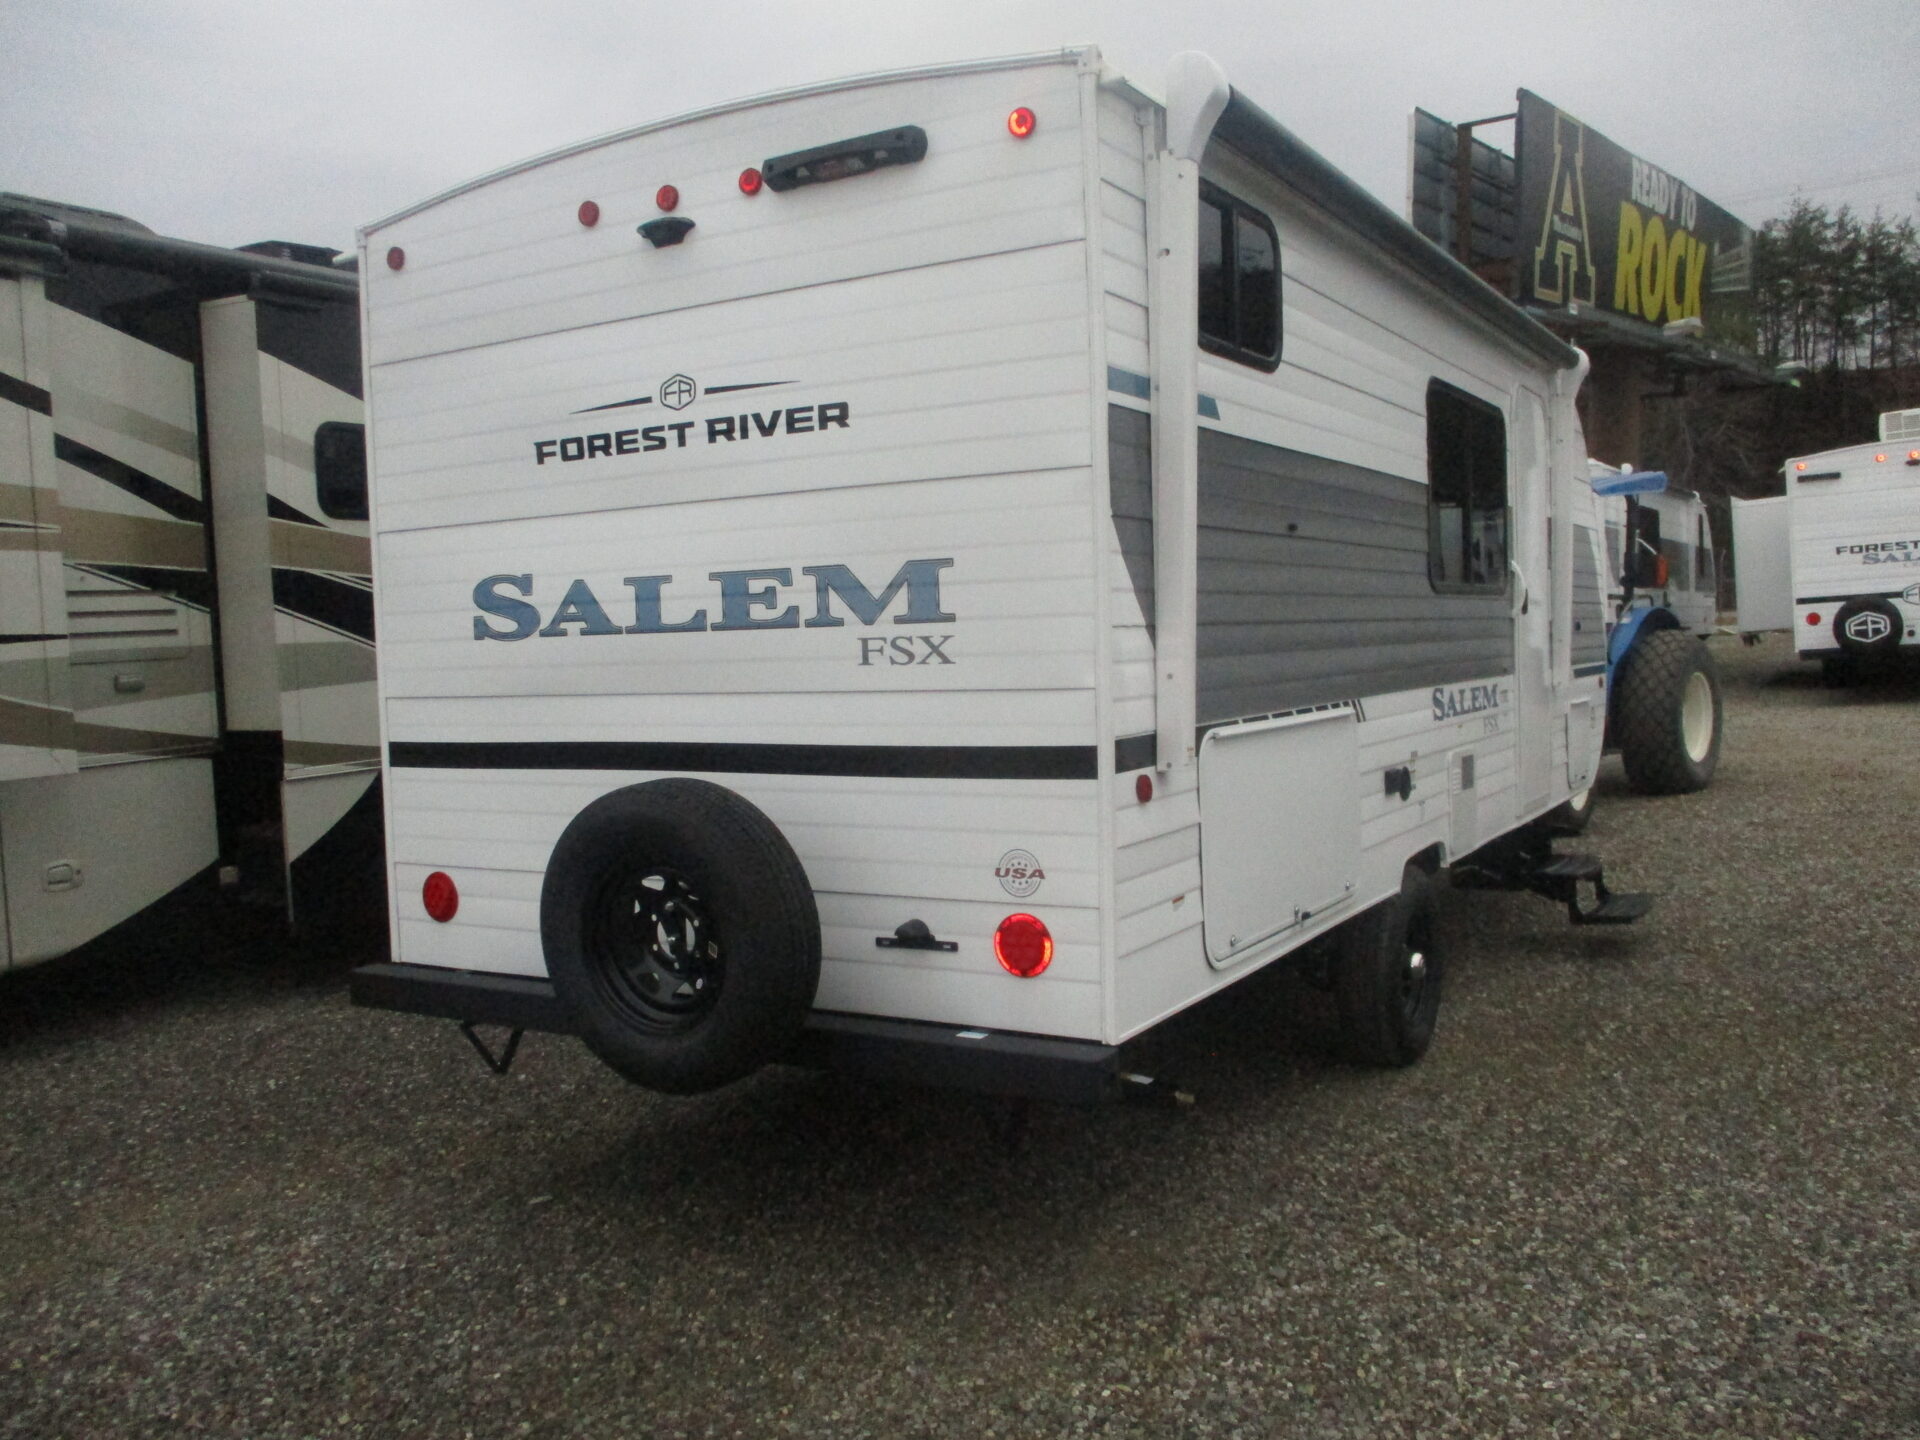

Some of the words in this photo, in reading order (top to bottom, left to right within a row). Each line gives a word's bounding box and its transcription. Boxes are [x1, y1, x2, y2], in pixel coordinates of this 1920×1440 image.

[1534, 107, 1595, 307] A
[1631, 157, 1680, 221] READY
[1680, 184, 1697, 232] TO
[1614, 200, 1707, 338] ROCK
[534, 421, 695, 465] FOREST
[704, 401, 851, 444] RIVER
[1836, 540, 1920, 555] FOREST
[472, 557, 957, 642] SALEM
[857, 634, 956, 666] FSX
[1432, 683, 1499, 721] SALEM
[994, 867, 1046, 880] USA
